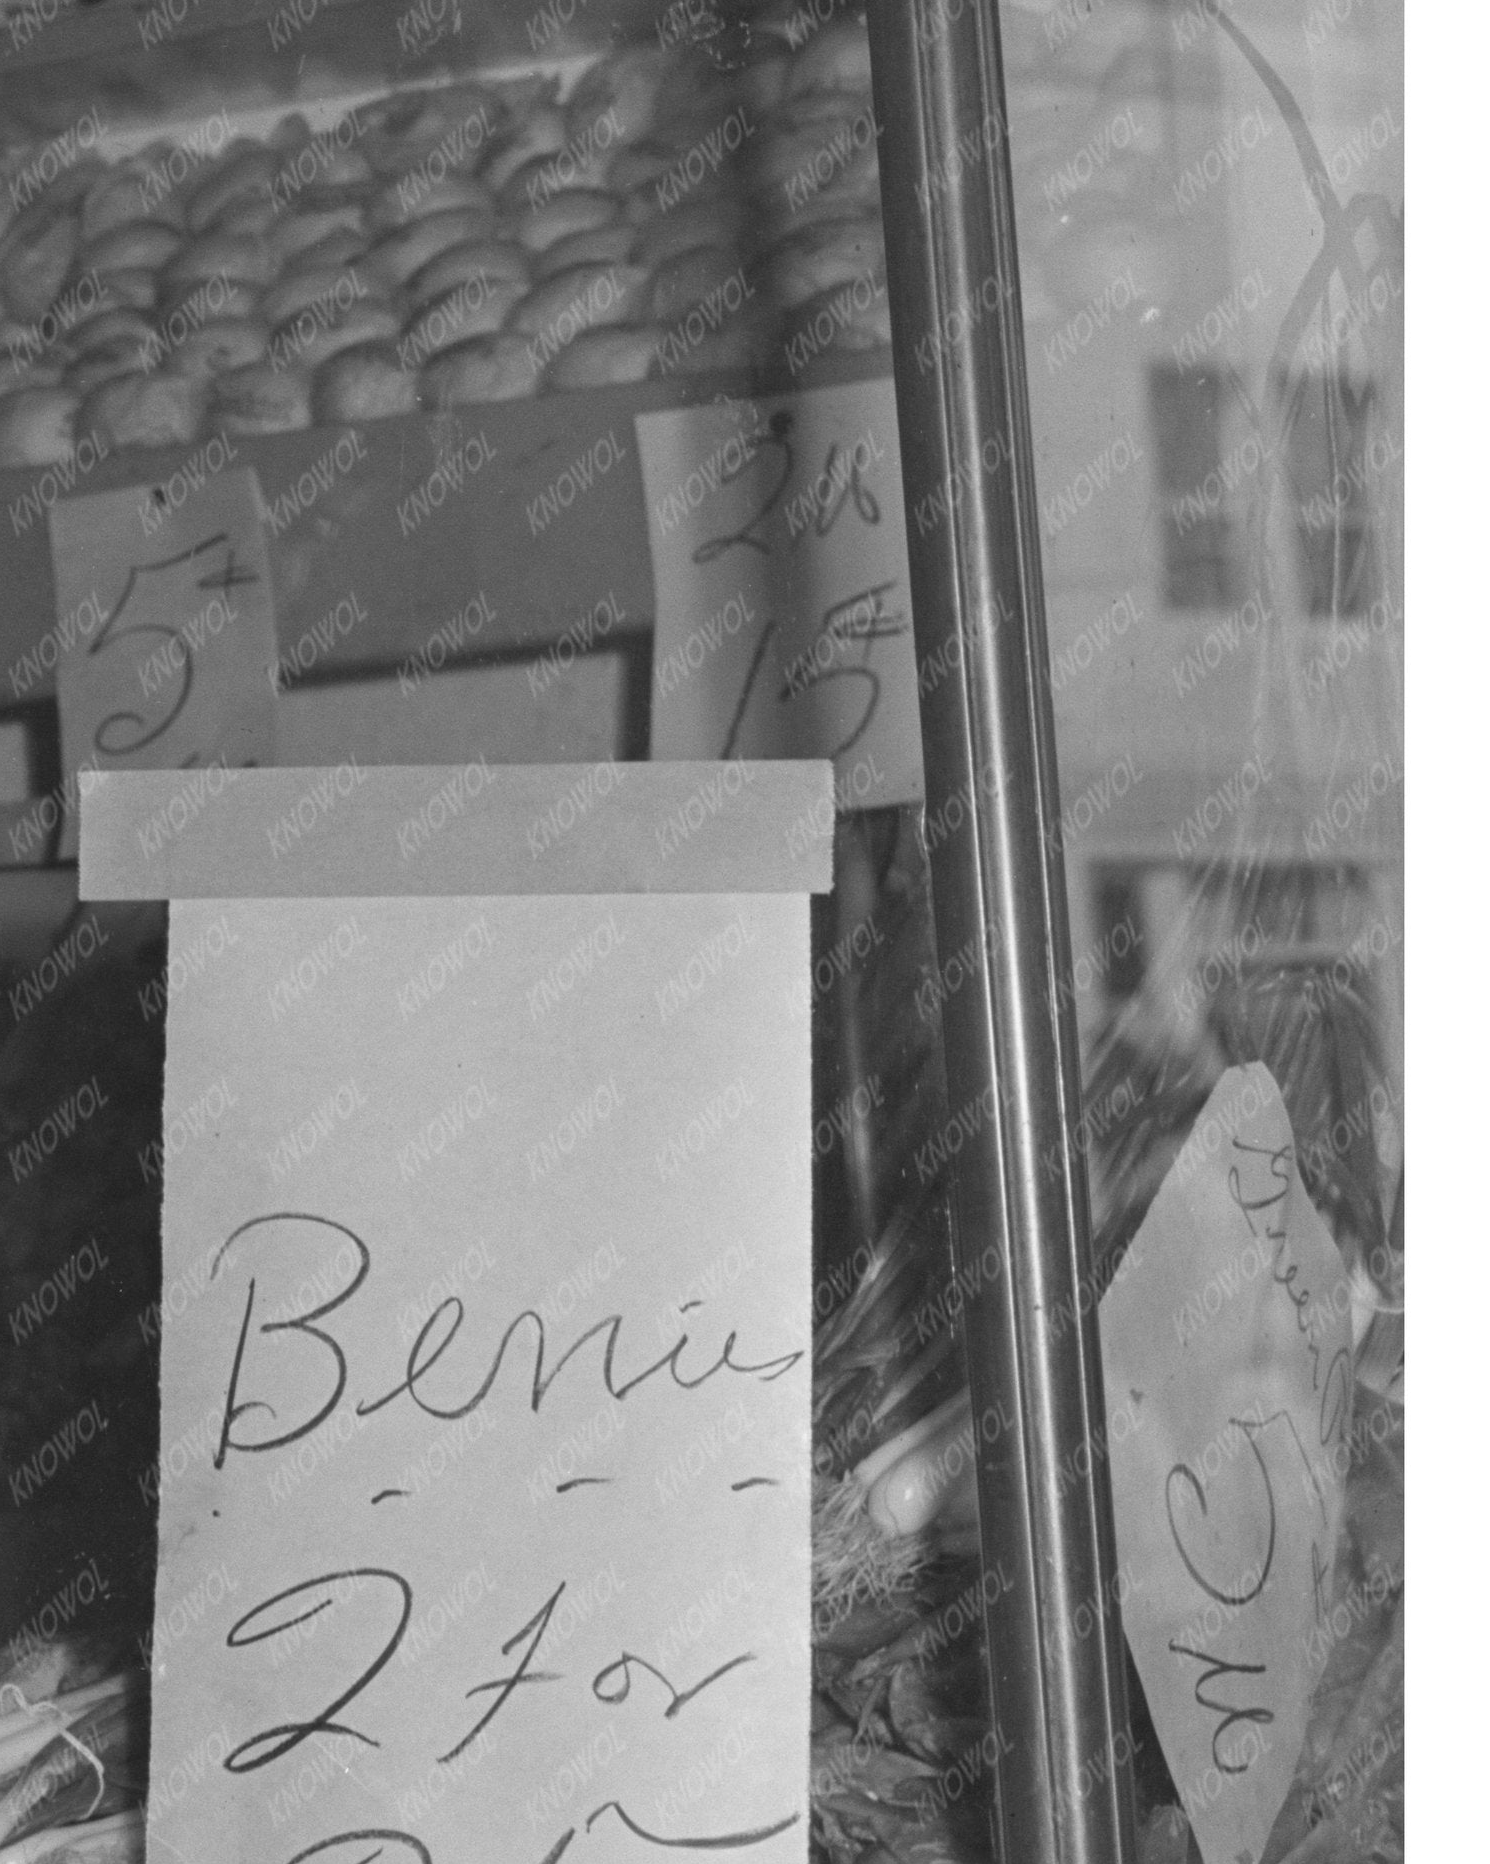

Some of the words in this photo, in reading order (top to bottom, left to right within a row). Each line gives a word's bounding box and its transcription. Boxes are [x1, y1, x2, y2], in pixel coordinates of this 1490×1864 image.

[692, 431, 795, 565] 2
[224, 1568, 413, 1773] 2
[436, 1581, 756, 1766] for
